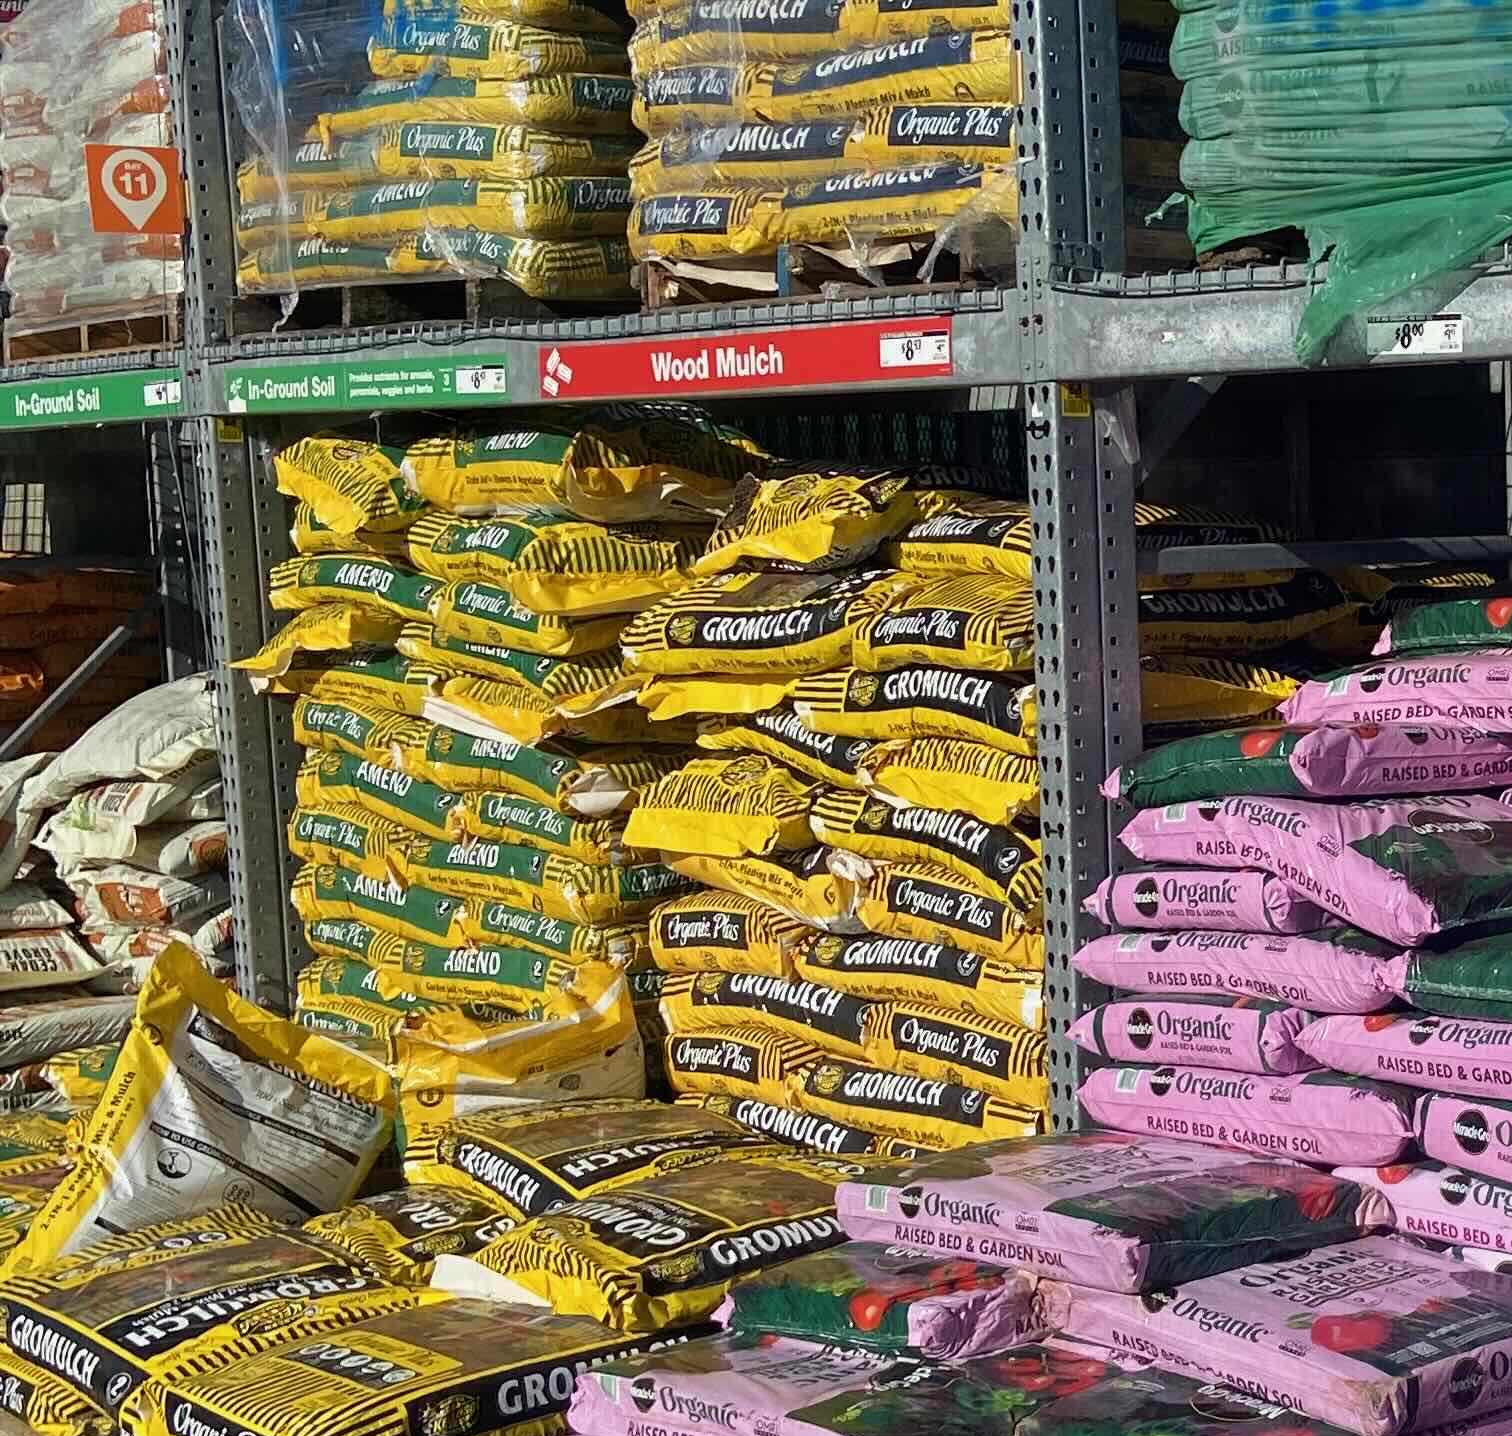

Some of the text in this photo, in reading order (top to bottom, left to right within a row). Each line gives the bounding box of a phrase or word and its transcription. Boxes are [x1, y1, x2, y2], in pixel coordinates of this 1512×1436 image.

[403, 23, 479, 52] Organic Plus
[407, 125, 485, 156] Organic Plus
[898, 110, 1001, 144] Organic Plus
[120, 172, 147, 195] 11
[651, 344, 783, 382] Wood Mulch
[15, 387, 100, 417] In-Ground Soil
[248, 377, 309, 400] In-Ground
[313, 375, 335, 397] Soil
[486, 432, 539, 449] AMEND
[335, 563, 394, 594] AMEND
[703, 610, 811, 641] GROMULCH
[884, 669, 991, 707] GROMULCH
[1387, 661, 1471, 688] Organic
[1447, 705, 1505, 720] GARDEN
[357, 765, 411, 797] AMEND
[488, 796, 565, 835] Organic Plus
[896, 879, 994, 929] Organic Plus
[1163, 878, 1237, 907] Organic
[444, 950, 500, 975] AMEND
[843, 940, 939, 968] GROMULCH
[1158, 1010, 1233, 1041] Organic
[899, 1018, 1000, 1066] Organic Plus
[1377, 1055, 1423, 1076] RAISED
[1428, 1062, 1453, 1078] BED
[1457, 1066, 1467, 1080] &
[844, 1073, 943, 1107] GROMULCH
[1176, 1072, 1254, 1100] Organic
[737, 1101, 848, 1152] GROMULCH
[1147, 1116, 1322, 1154] RAISED BED & GARDEN SOIL
[895, 1224, 1066, 1267] RAISED BED GARDEN SOIL
[1406, 1216, 1458, 1241] RAISED
[1463, 1227, 1491, 1246] BED
[1496, 1232, 1507, 1248] &
[1172, 1296, 1271, 1344] Organic
[10, 1315, 99, 1385] GROMULCH
[661, 1387, 737, 1431] Organic
